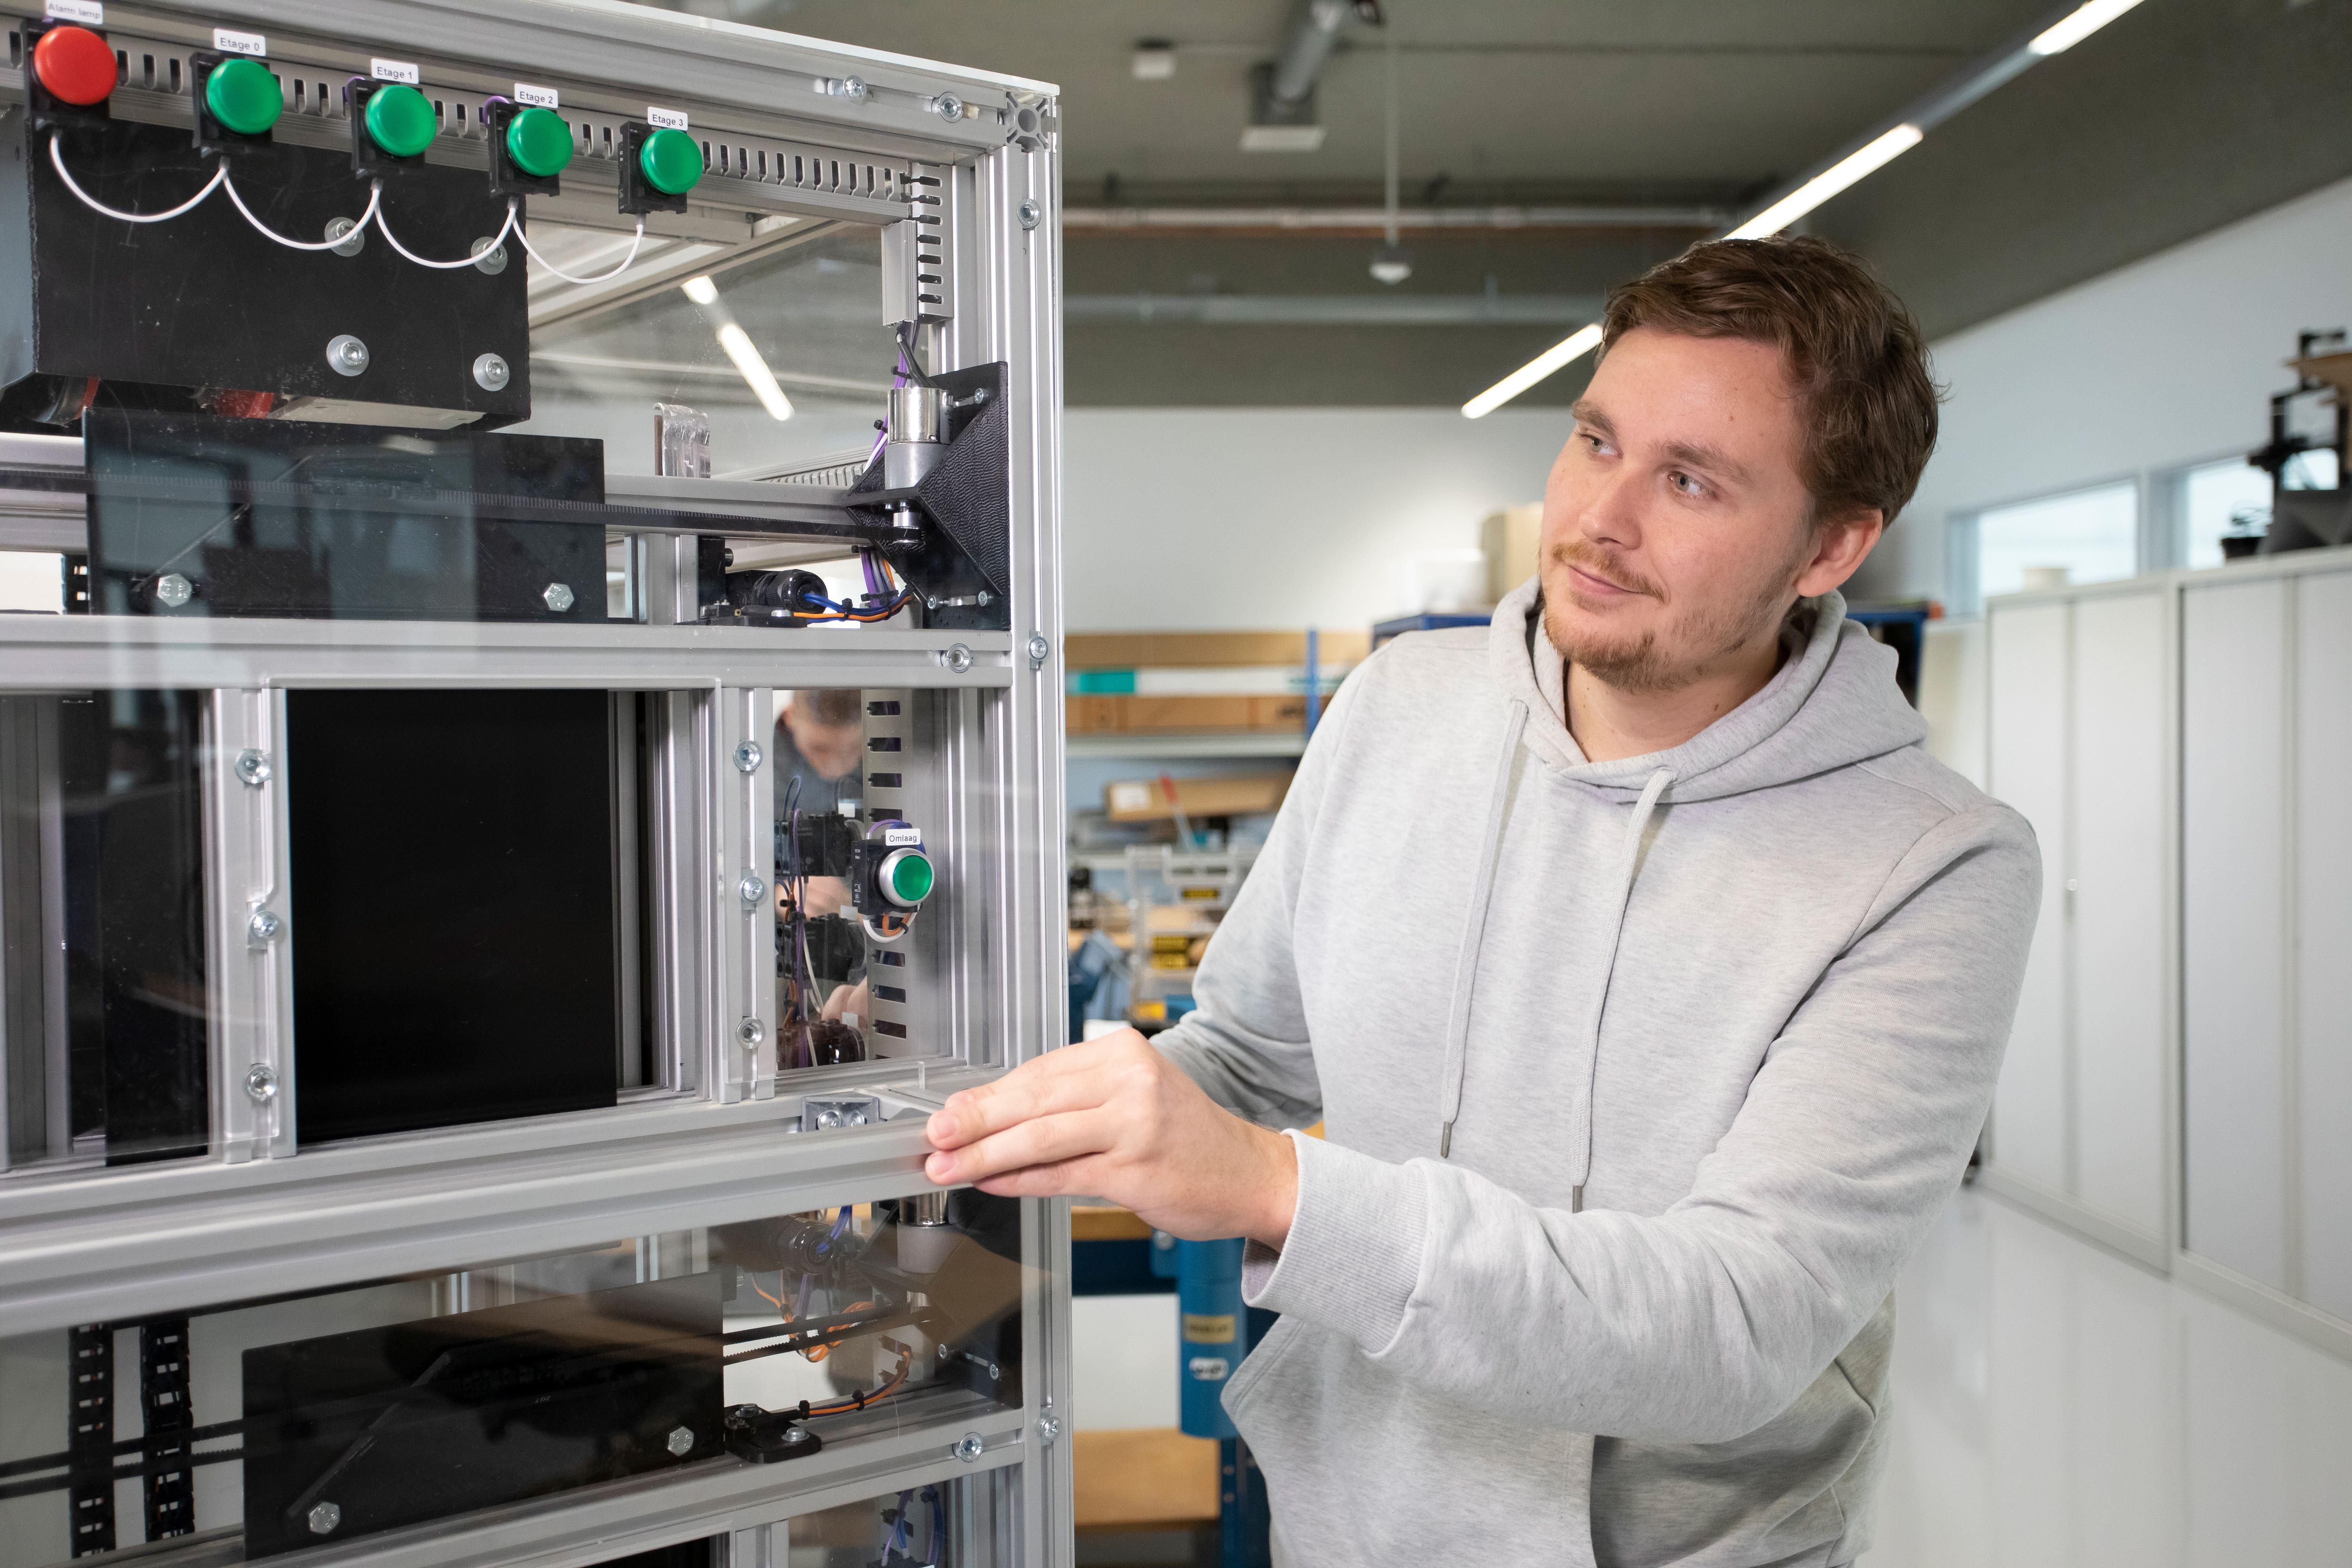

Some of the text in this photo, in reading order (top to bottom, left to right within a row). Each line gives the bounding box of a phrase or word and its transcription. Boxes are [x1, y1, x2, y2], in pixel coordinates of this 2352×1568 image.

[48, 3, 100, 20] Alarm lamp
[220, 37, 260, 51] Etage 0
[377, 66, 412, 80] Etage 1
[519, 91, 545, 103] Etage
[652, 114, 676, 127] Etage
[889, 835, 917, 843] Omlaag
